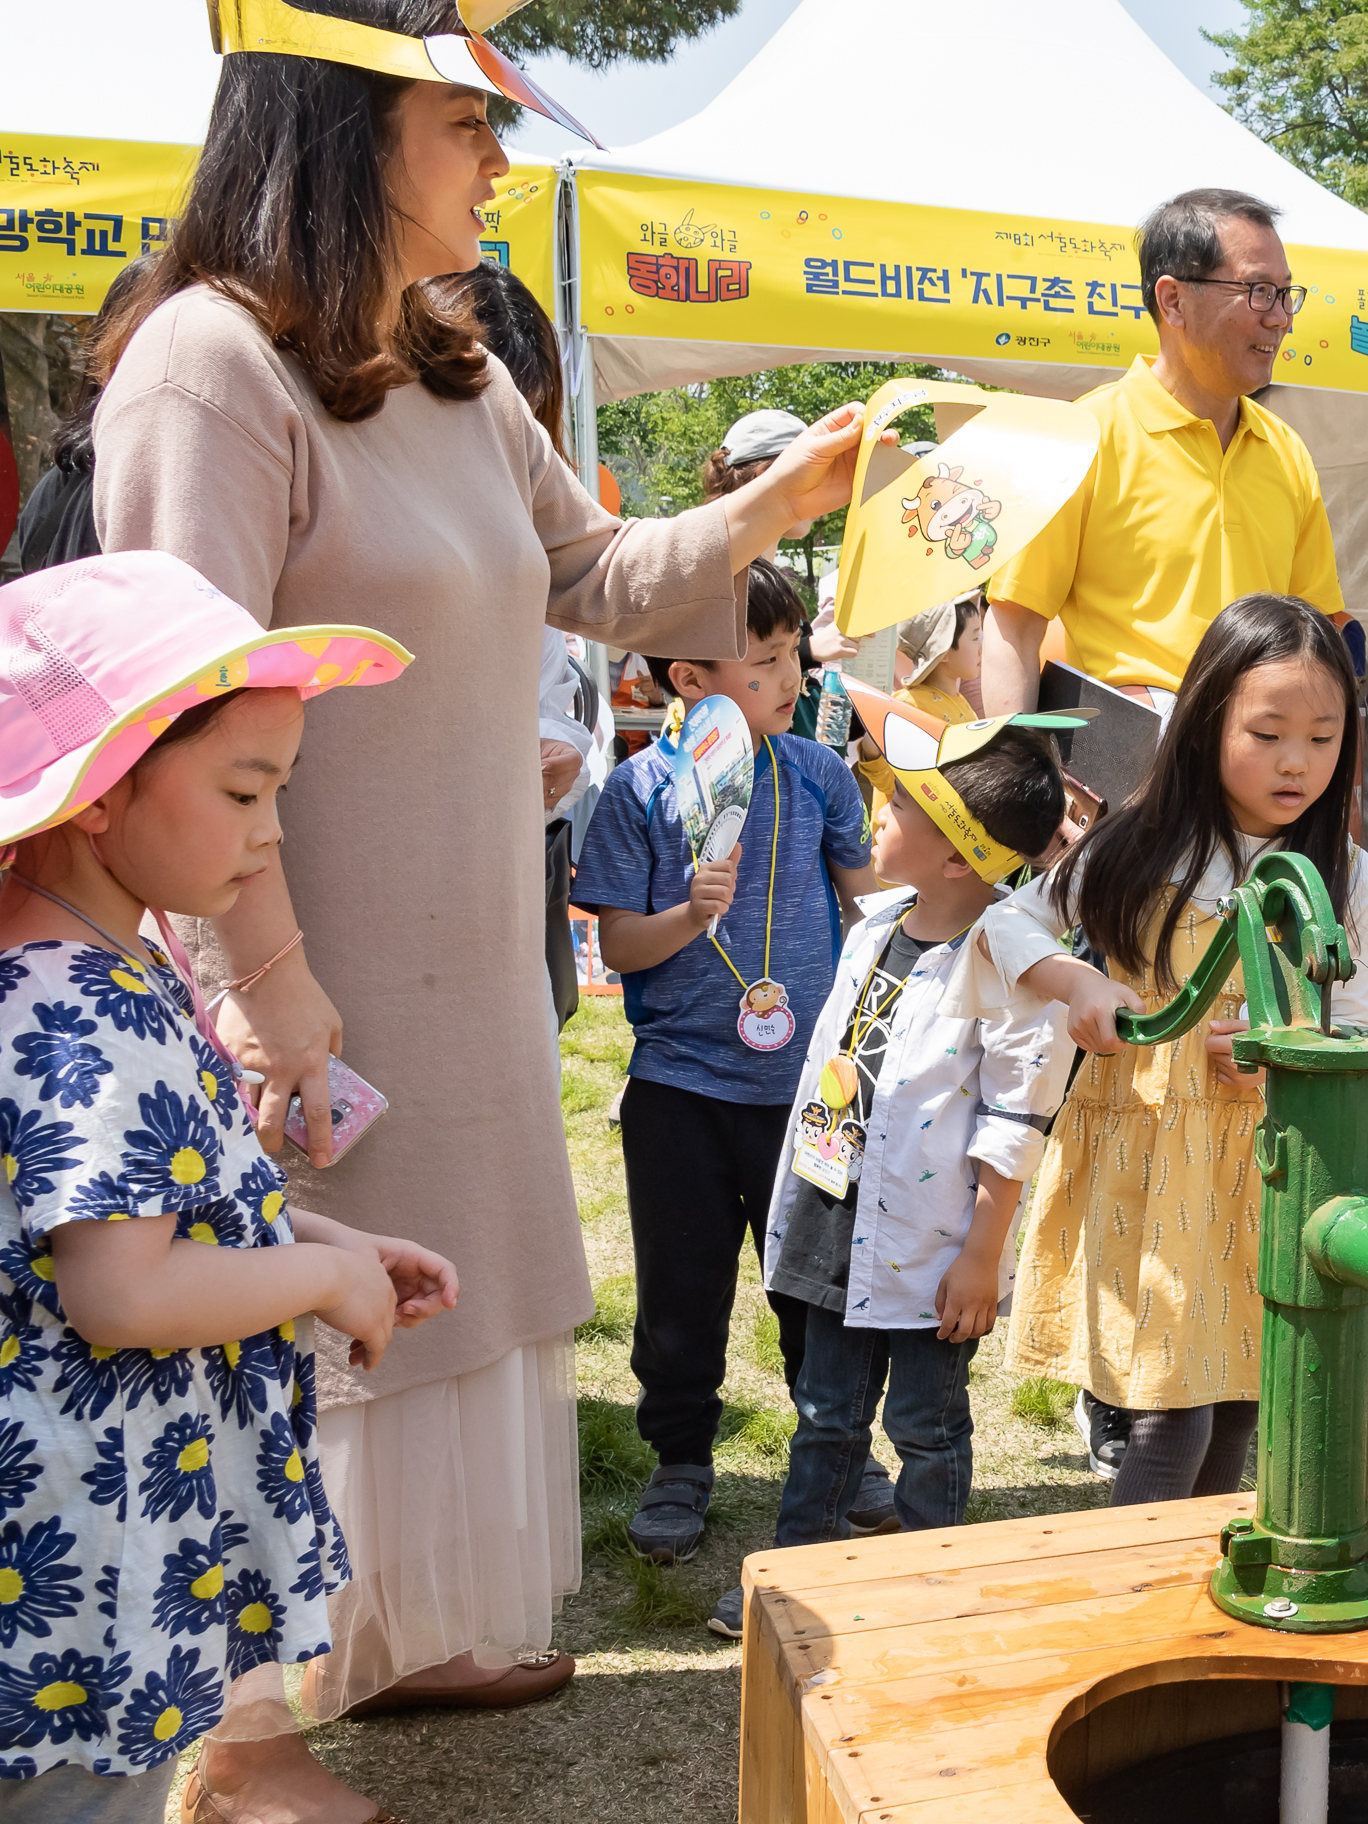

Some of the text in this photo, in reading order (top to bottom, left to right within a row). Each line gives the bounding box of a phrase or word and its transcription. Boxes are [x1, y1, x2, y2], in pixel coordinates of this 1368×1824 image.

[0, 148, 100, 185] 울동화축제
[640, 221, 738, 253] 와글 와글
[1038, 231, 1126, 261] 서울동화축제
[15, 272, 36, 286] 서울
[25, 281, 85, 295] 어린이대공원
[627, 252, 752, 303] 동화나라
[803, 257, 951, 304] 월드비전
[961, 267, 1076, 313] '지구촌
[1015, 335, 1051, 347] 광진구
[1076, 341, 1120, 352] 어린이대공원
